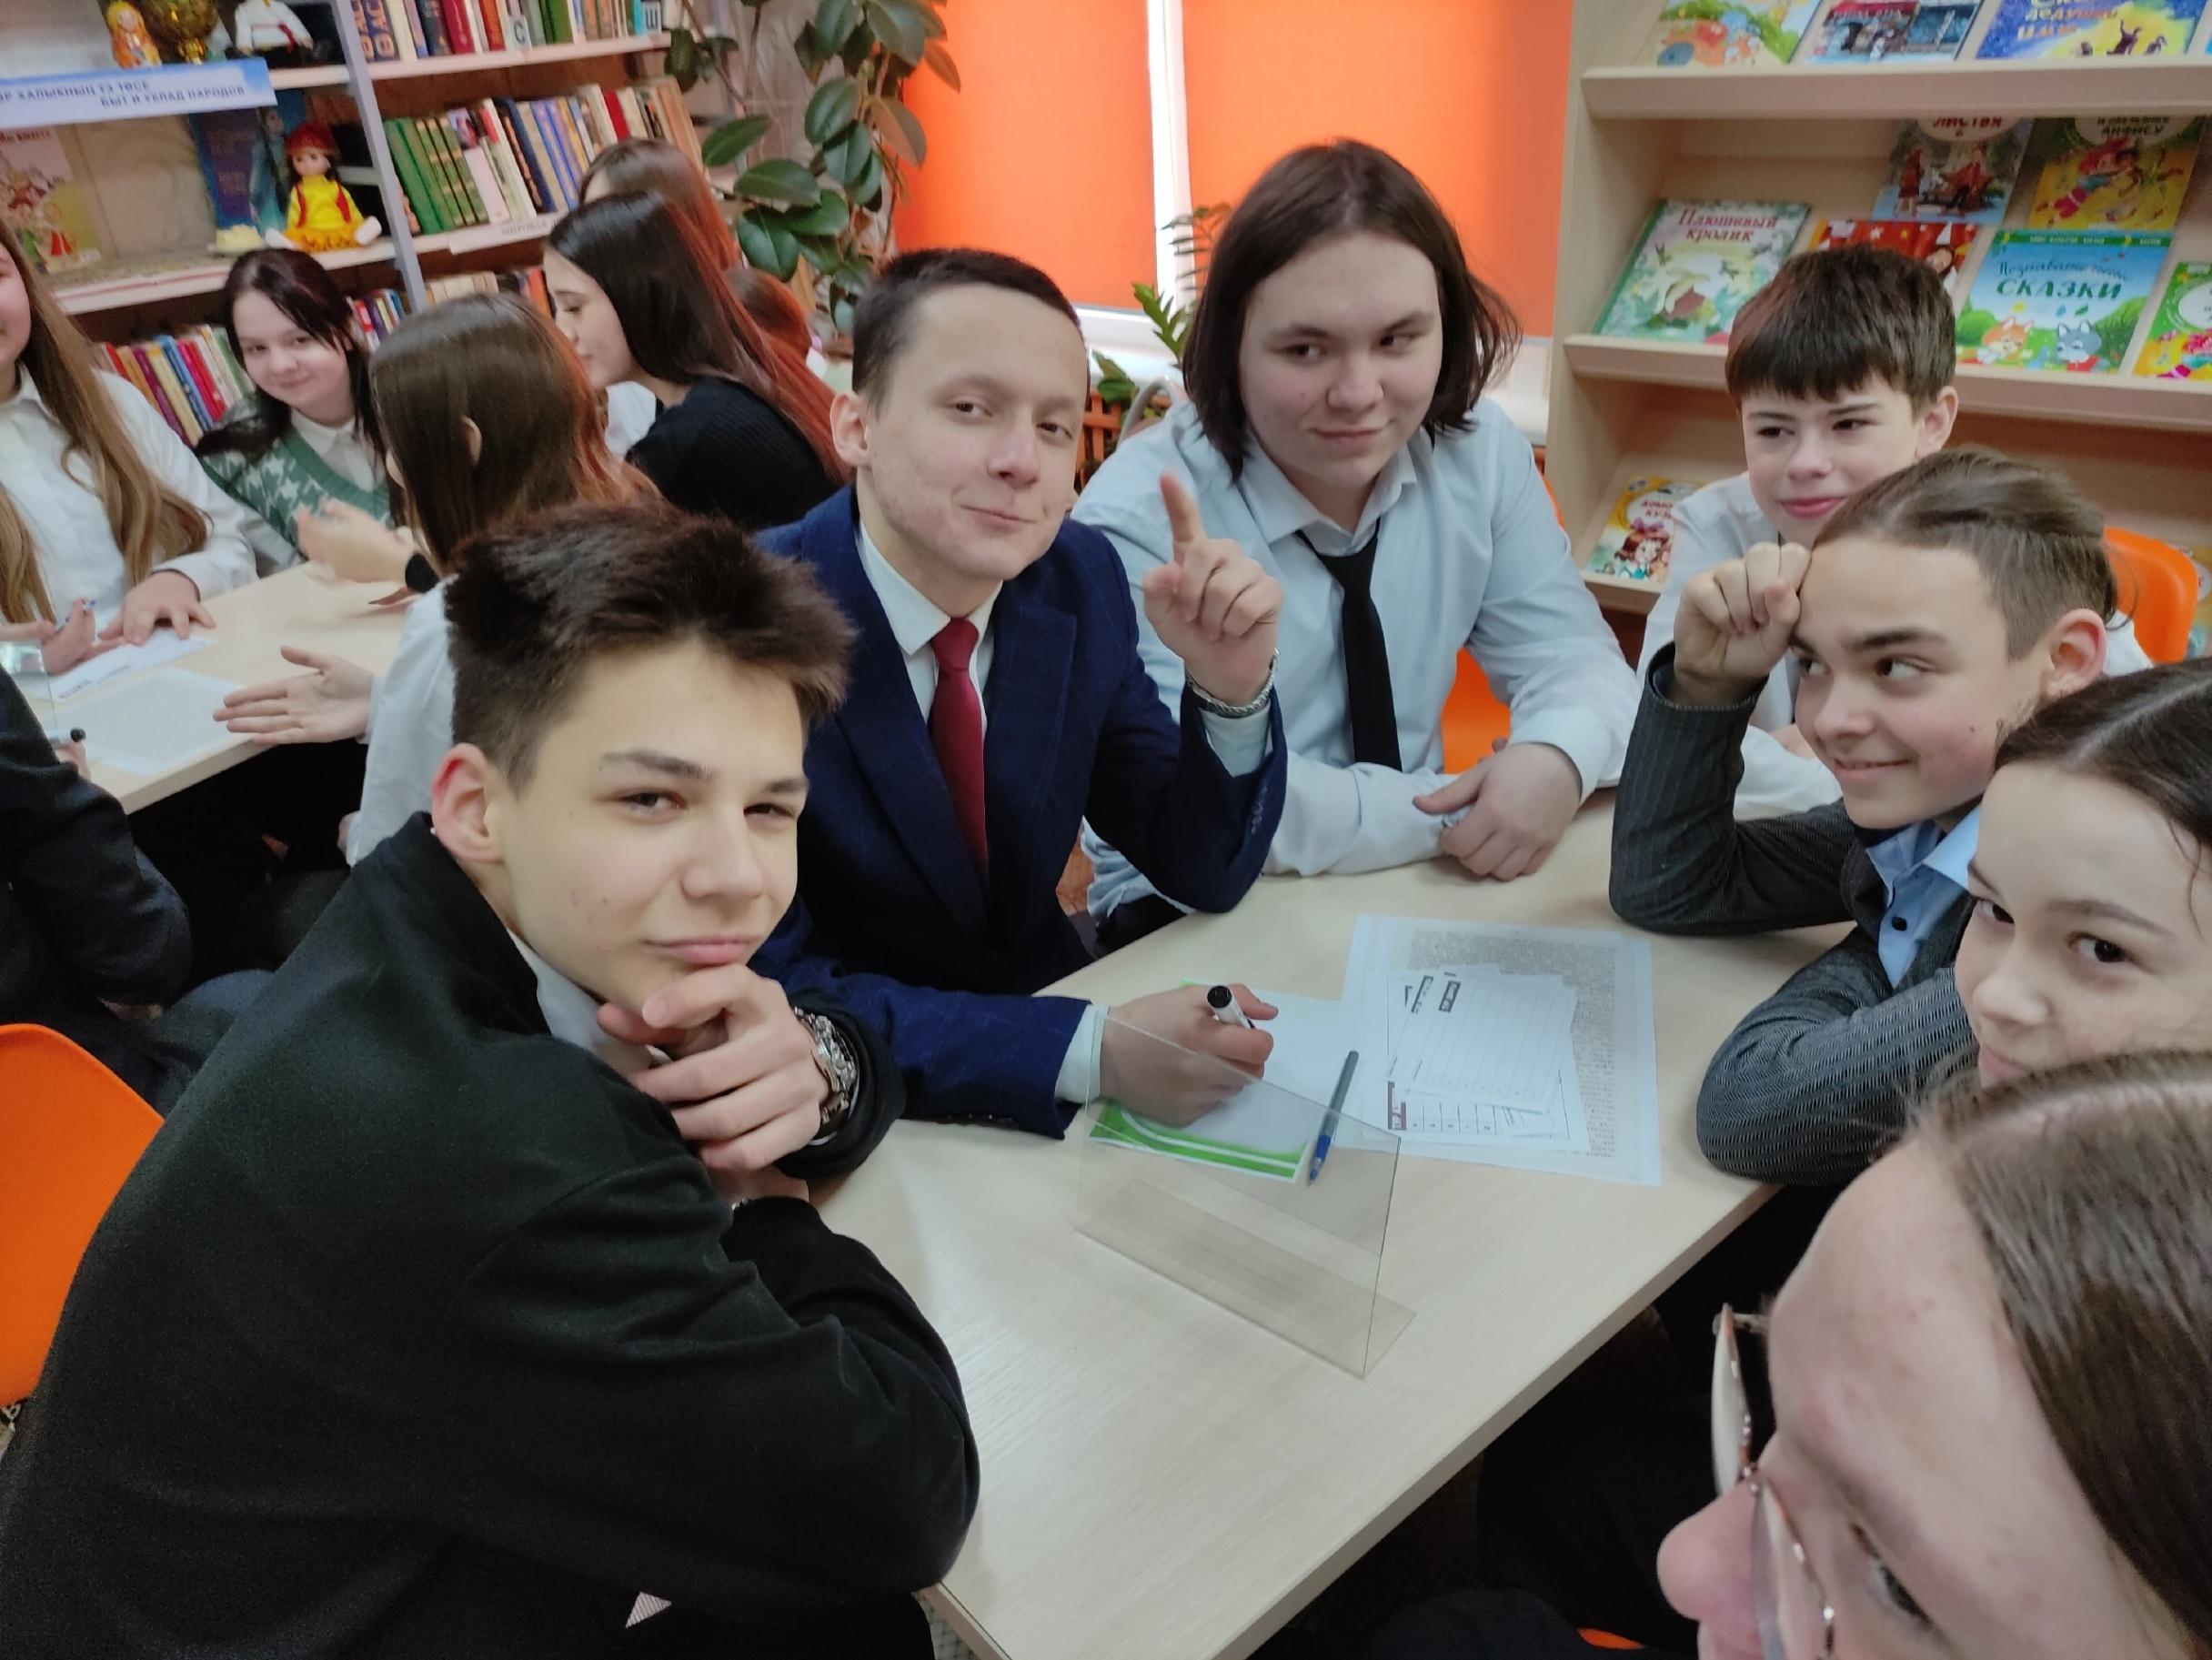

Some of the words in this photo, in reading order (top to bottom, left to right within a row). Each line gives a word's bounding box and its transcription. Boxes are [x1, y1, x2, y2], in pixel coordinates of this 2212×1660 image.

[513, 20, 526, 44] С
[101, 95, 128, 107] БЫТ
[132, 96, 141, 105] И
[145, 92, 185, 104] УКЛАД
[187, 86, 246, 99] НАРОДОВ
[1679, 208, 1779, 228] Плюшевый
[1686, 228, 1754, 243] кролик
[1996, 279, 2122, 298] СКАЗКИ
